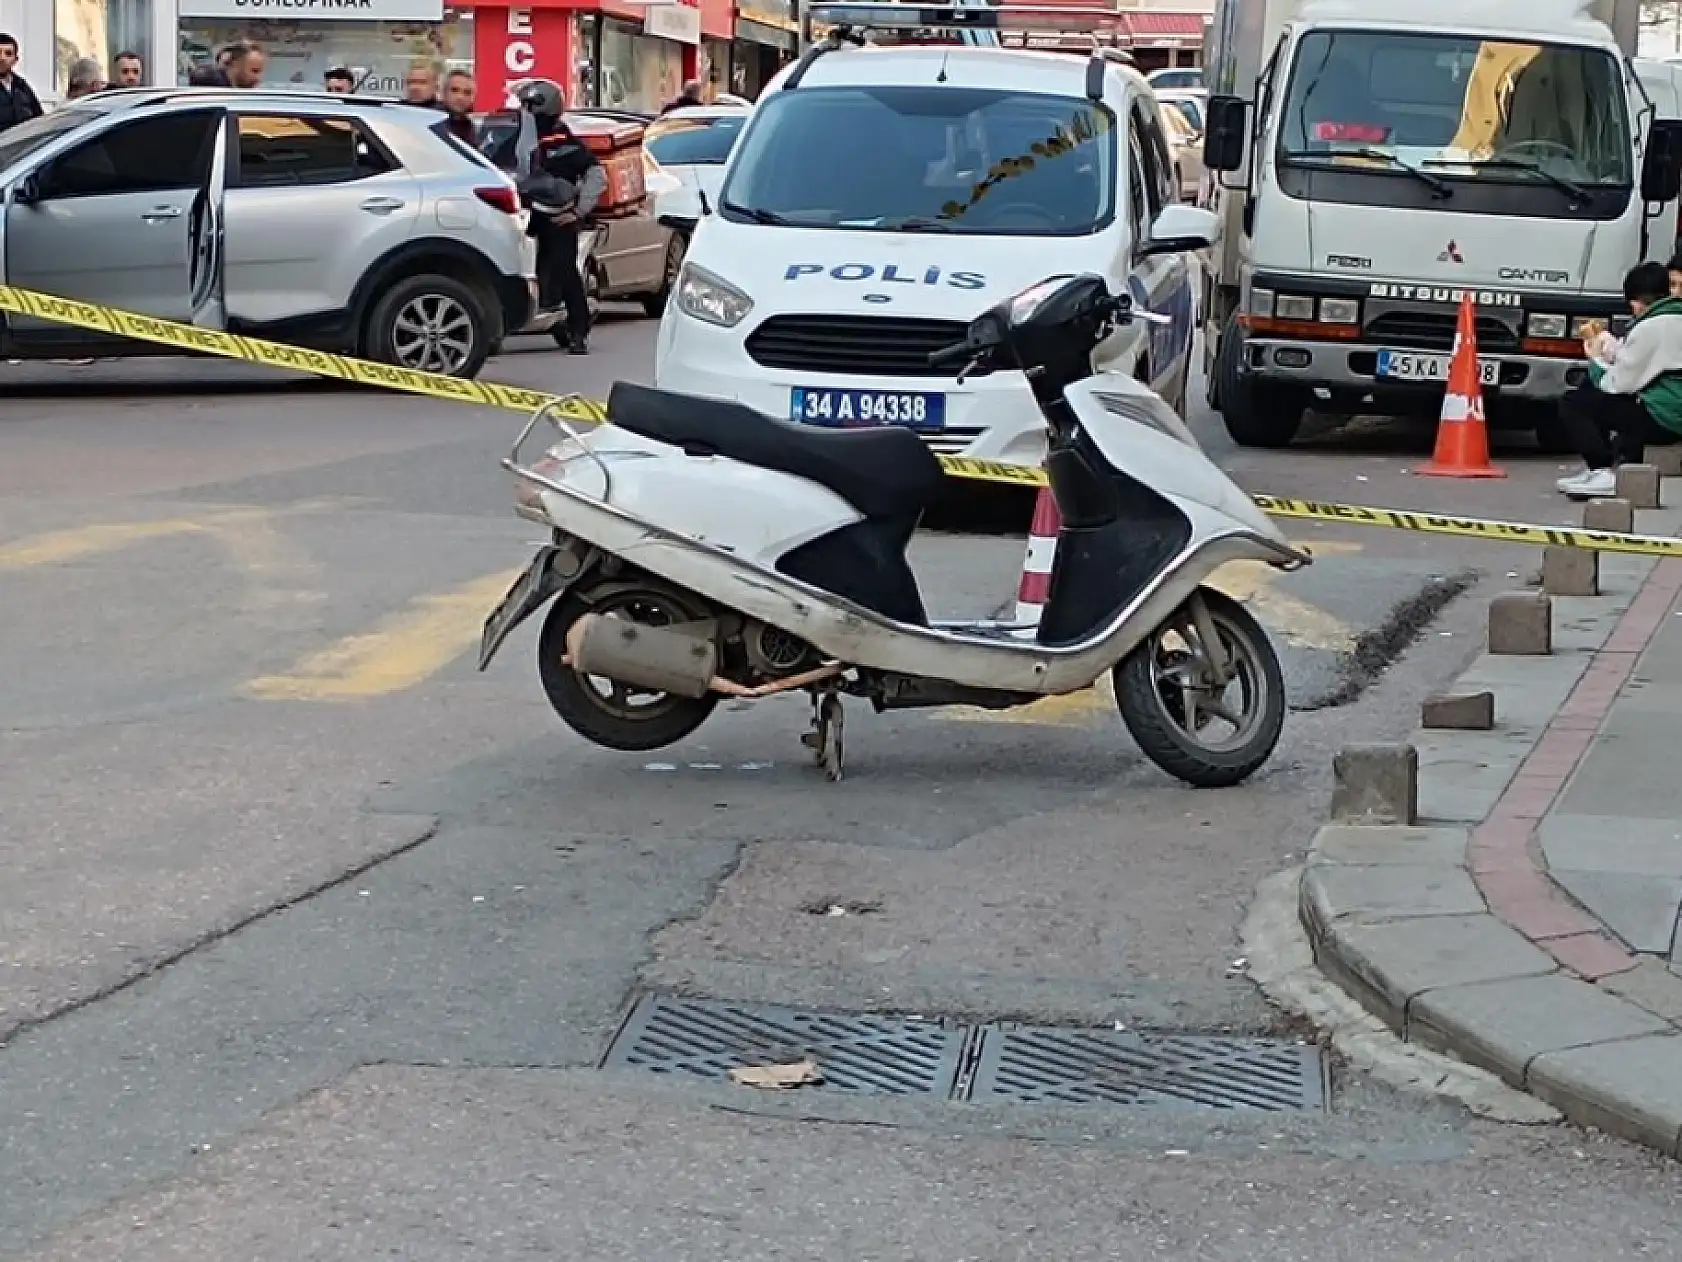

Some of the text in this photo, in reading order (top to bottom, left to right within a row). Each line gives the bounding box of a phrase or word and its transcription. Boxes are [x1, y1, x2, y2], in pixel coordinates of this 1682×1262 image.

[806, 391, 926, 422] 34 A 94338
